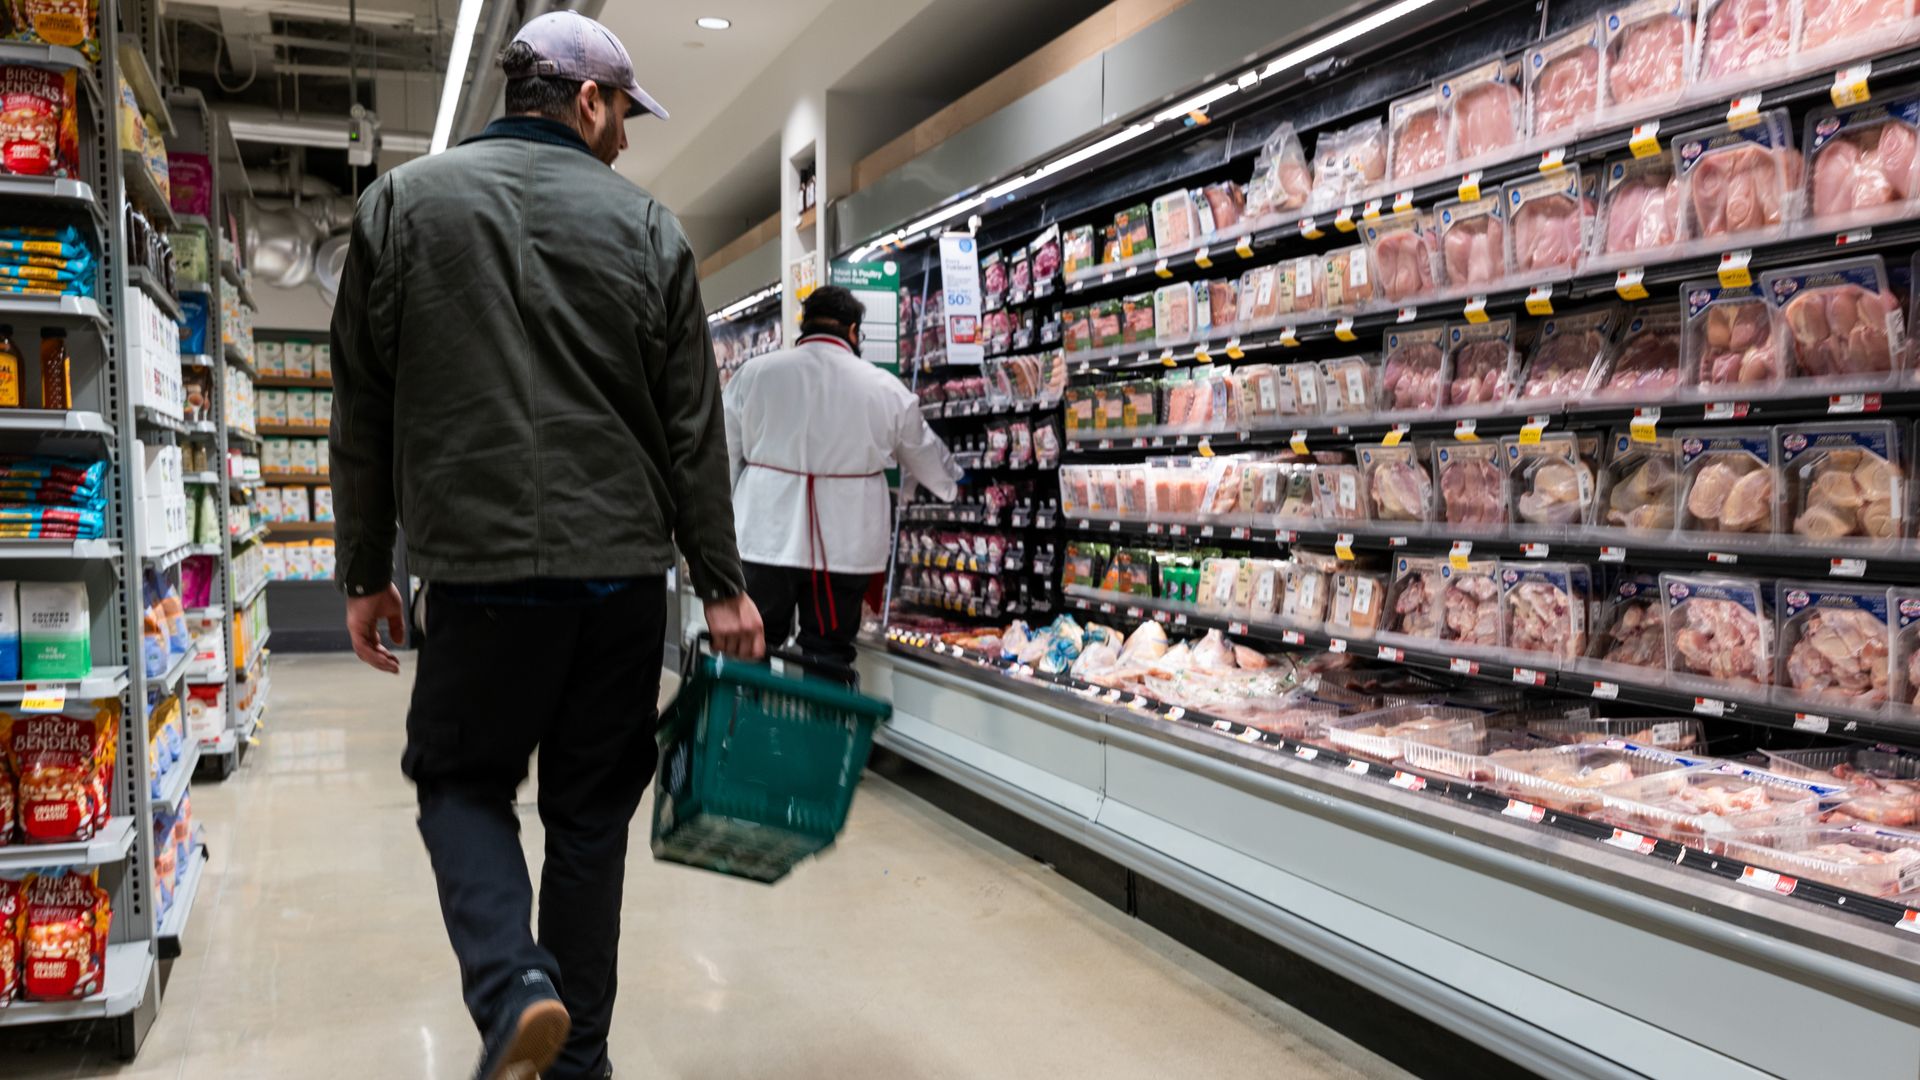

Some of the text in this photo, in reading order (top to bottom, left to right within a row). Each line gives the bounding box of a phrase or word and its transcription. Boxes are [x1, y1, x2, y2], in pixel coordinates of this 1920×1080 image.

[6, 67, 49, 83] BIRCH
[7, 95, 46, 107] COMPLETE
[859, 270, 883, 280] Poultry
[28, 720, 79, 736] BIRCH
[14, 735, 90, 752] BENDERS
[28, 752, 74, 763] COMPLETE
[34, 803, 69, 814] ORGANIC
[35, 811, 69, 822] CLASSIC
[37, 876, 82, 890] BIRCH
[34, 908, 78, 918] COMPLETE
[33, 961, 68, 971] ORGANIC
[34, 969, 66, 979] CLASSIC
